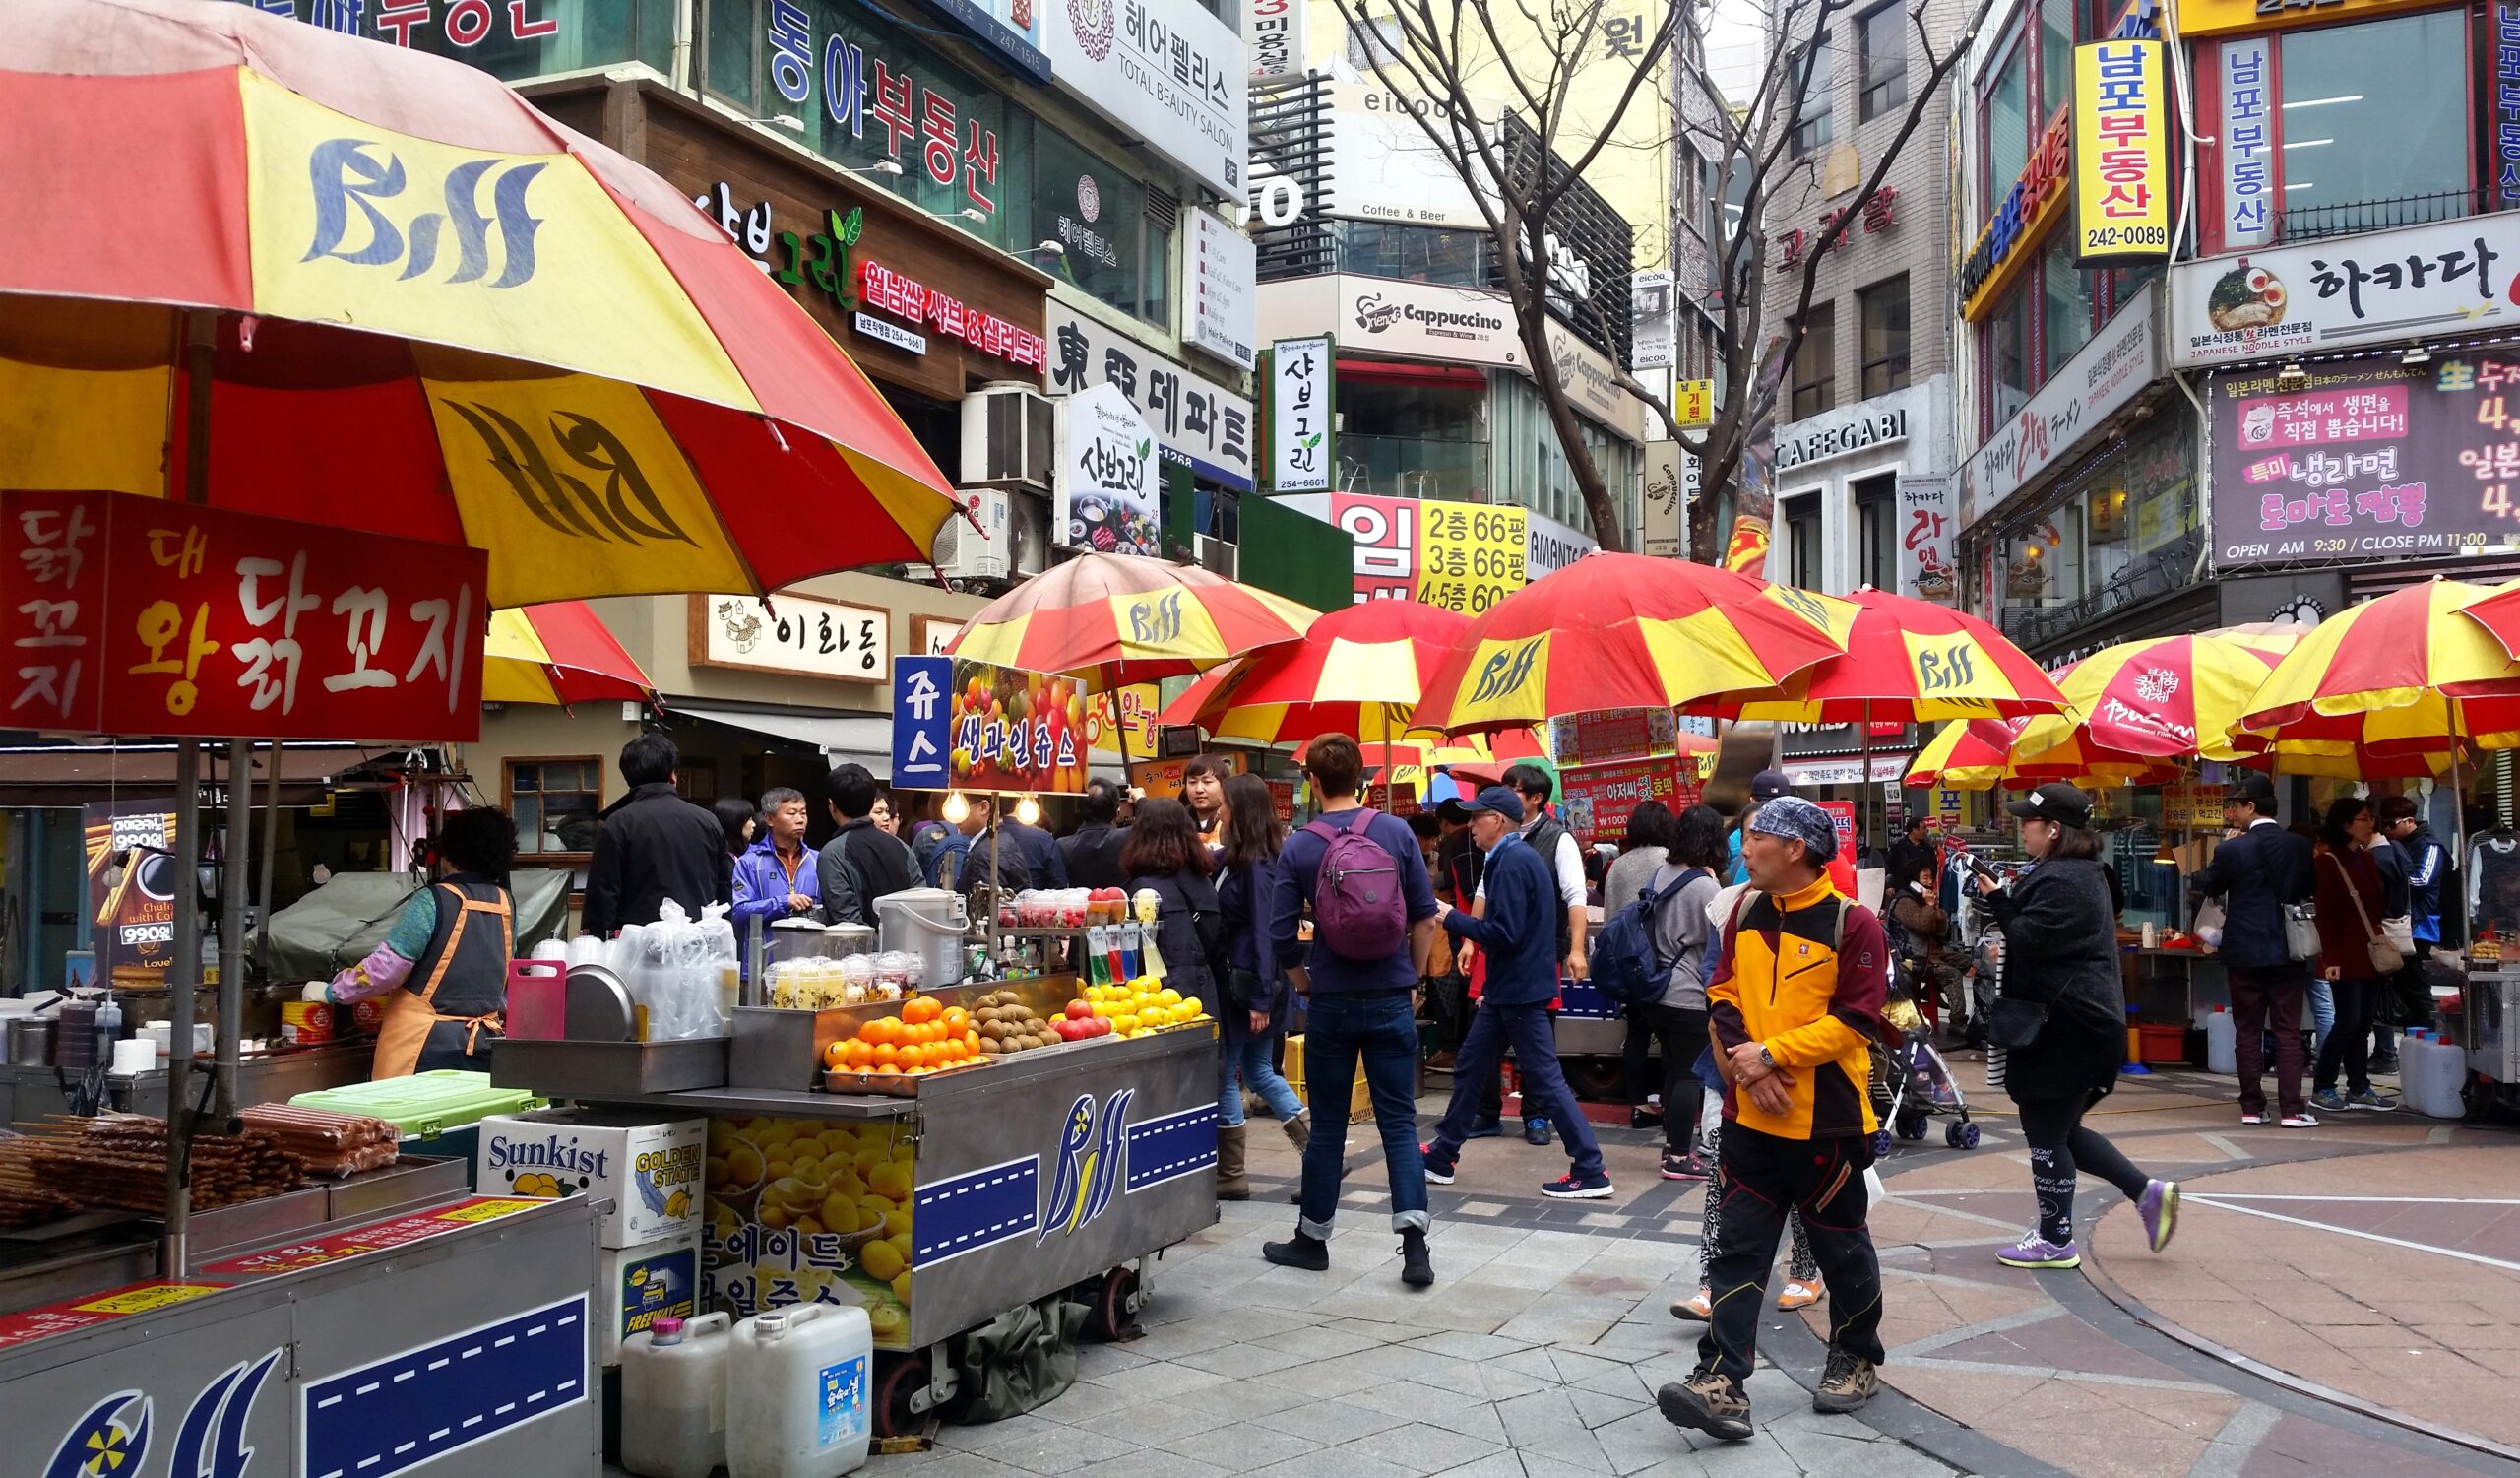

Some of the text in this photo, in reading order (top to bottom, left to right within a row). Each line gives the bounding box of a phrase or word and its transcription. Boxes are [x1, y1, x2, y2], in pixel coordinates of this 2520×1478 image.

[1126, 0, 1229, 112] 헤어펠리스
[767, 0, 1000, 214] 동아부동산
[1118, 52, 1233, 153] TOTAL BEAUTY SALON
[2097, 44, 2152, 218] 남포부동산
[2230, 50, 2267, 234] 남포부동산
[1226, 162, 1237, 183] 3F
[1362, 204, 1446, 222] Coffee & Beer
[2087, 226, 2166, 248] 242-0089
[1638, 273, 1666, 283] eicoo
[2309, 236, 2499, 319] 하카다
[864, 260, 924, 323] 월남쌈
[926, 290, 966, 338] 샤브
[1404, 303, 1503, 331] Cappuccino
[891, 329, 923, 352] 254-6661
[1208, 325, 1235, 349] Hair Palace
[2190, 335, 2313, 358] JAPANESE NOODLE STYLE
[1639, 353, 1666, 363] eicoo
[1285, 352, 1315, 473] 샤브그린
[2275, 393, 2391, 420] 즉석에서 생면을
[1775, 409, 1907, 469] CAFEGABI
[2284, 414, 2405, 441] 직접 뽑습니다!
[1080, 436, 1147, 500] 샤브그린
[2250, 446, 2398, 486] 특미 냉라면
[1280, 479, 1326, 489] 254-6661
[1904, 490, 1946, 507] 하카다
[2260, 482, 2427, 530] 토마토 짬뽕
[1429, 507, 1525, 546] 2층 66평
[1428, 544, 1525, 581] 3층 66평
[2226, 544, 2269, 559] OPEN
[2278, 542, 2305, 555] AM
[2314, 539, 2347, 552] 9:30
[2361, 535, 2414, 551] CLOSE
[2417, 533, 2443, 547] PM
[2446, 532, 2488, 546] 11:00
[11, 504, 96, 719] 닭꼬지
[1471, 583, 1517, 613] 60
[231, 548, 473, 717] 닭꼬지
[775, 610, 877, 671] 이화동
[903, 670, 942, 773] 쥬스
[958, 715, 1077, 769] 생과일쥬스
[1871, 763, 1896, 779] K텔레콤
[124, 925, 172, 943] 990원
[129, 911, 154, 924] with
[488, 1134, 609, 1180] Sunkist
[636, 1142, 702, 1174] GOLDEN
[654, 1164, 701, 1189] STATE
